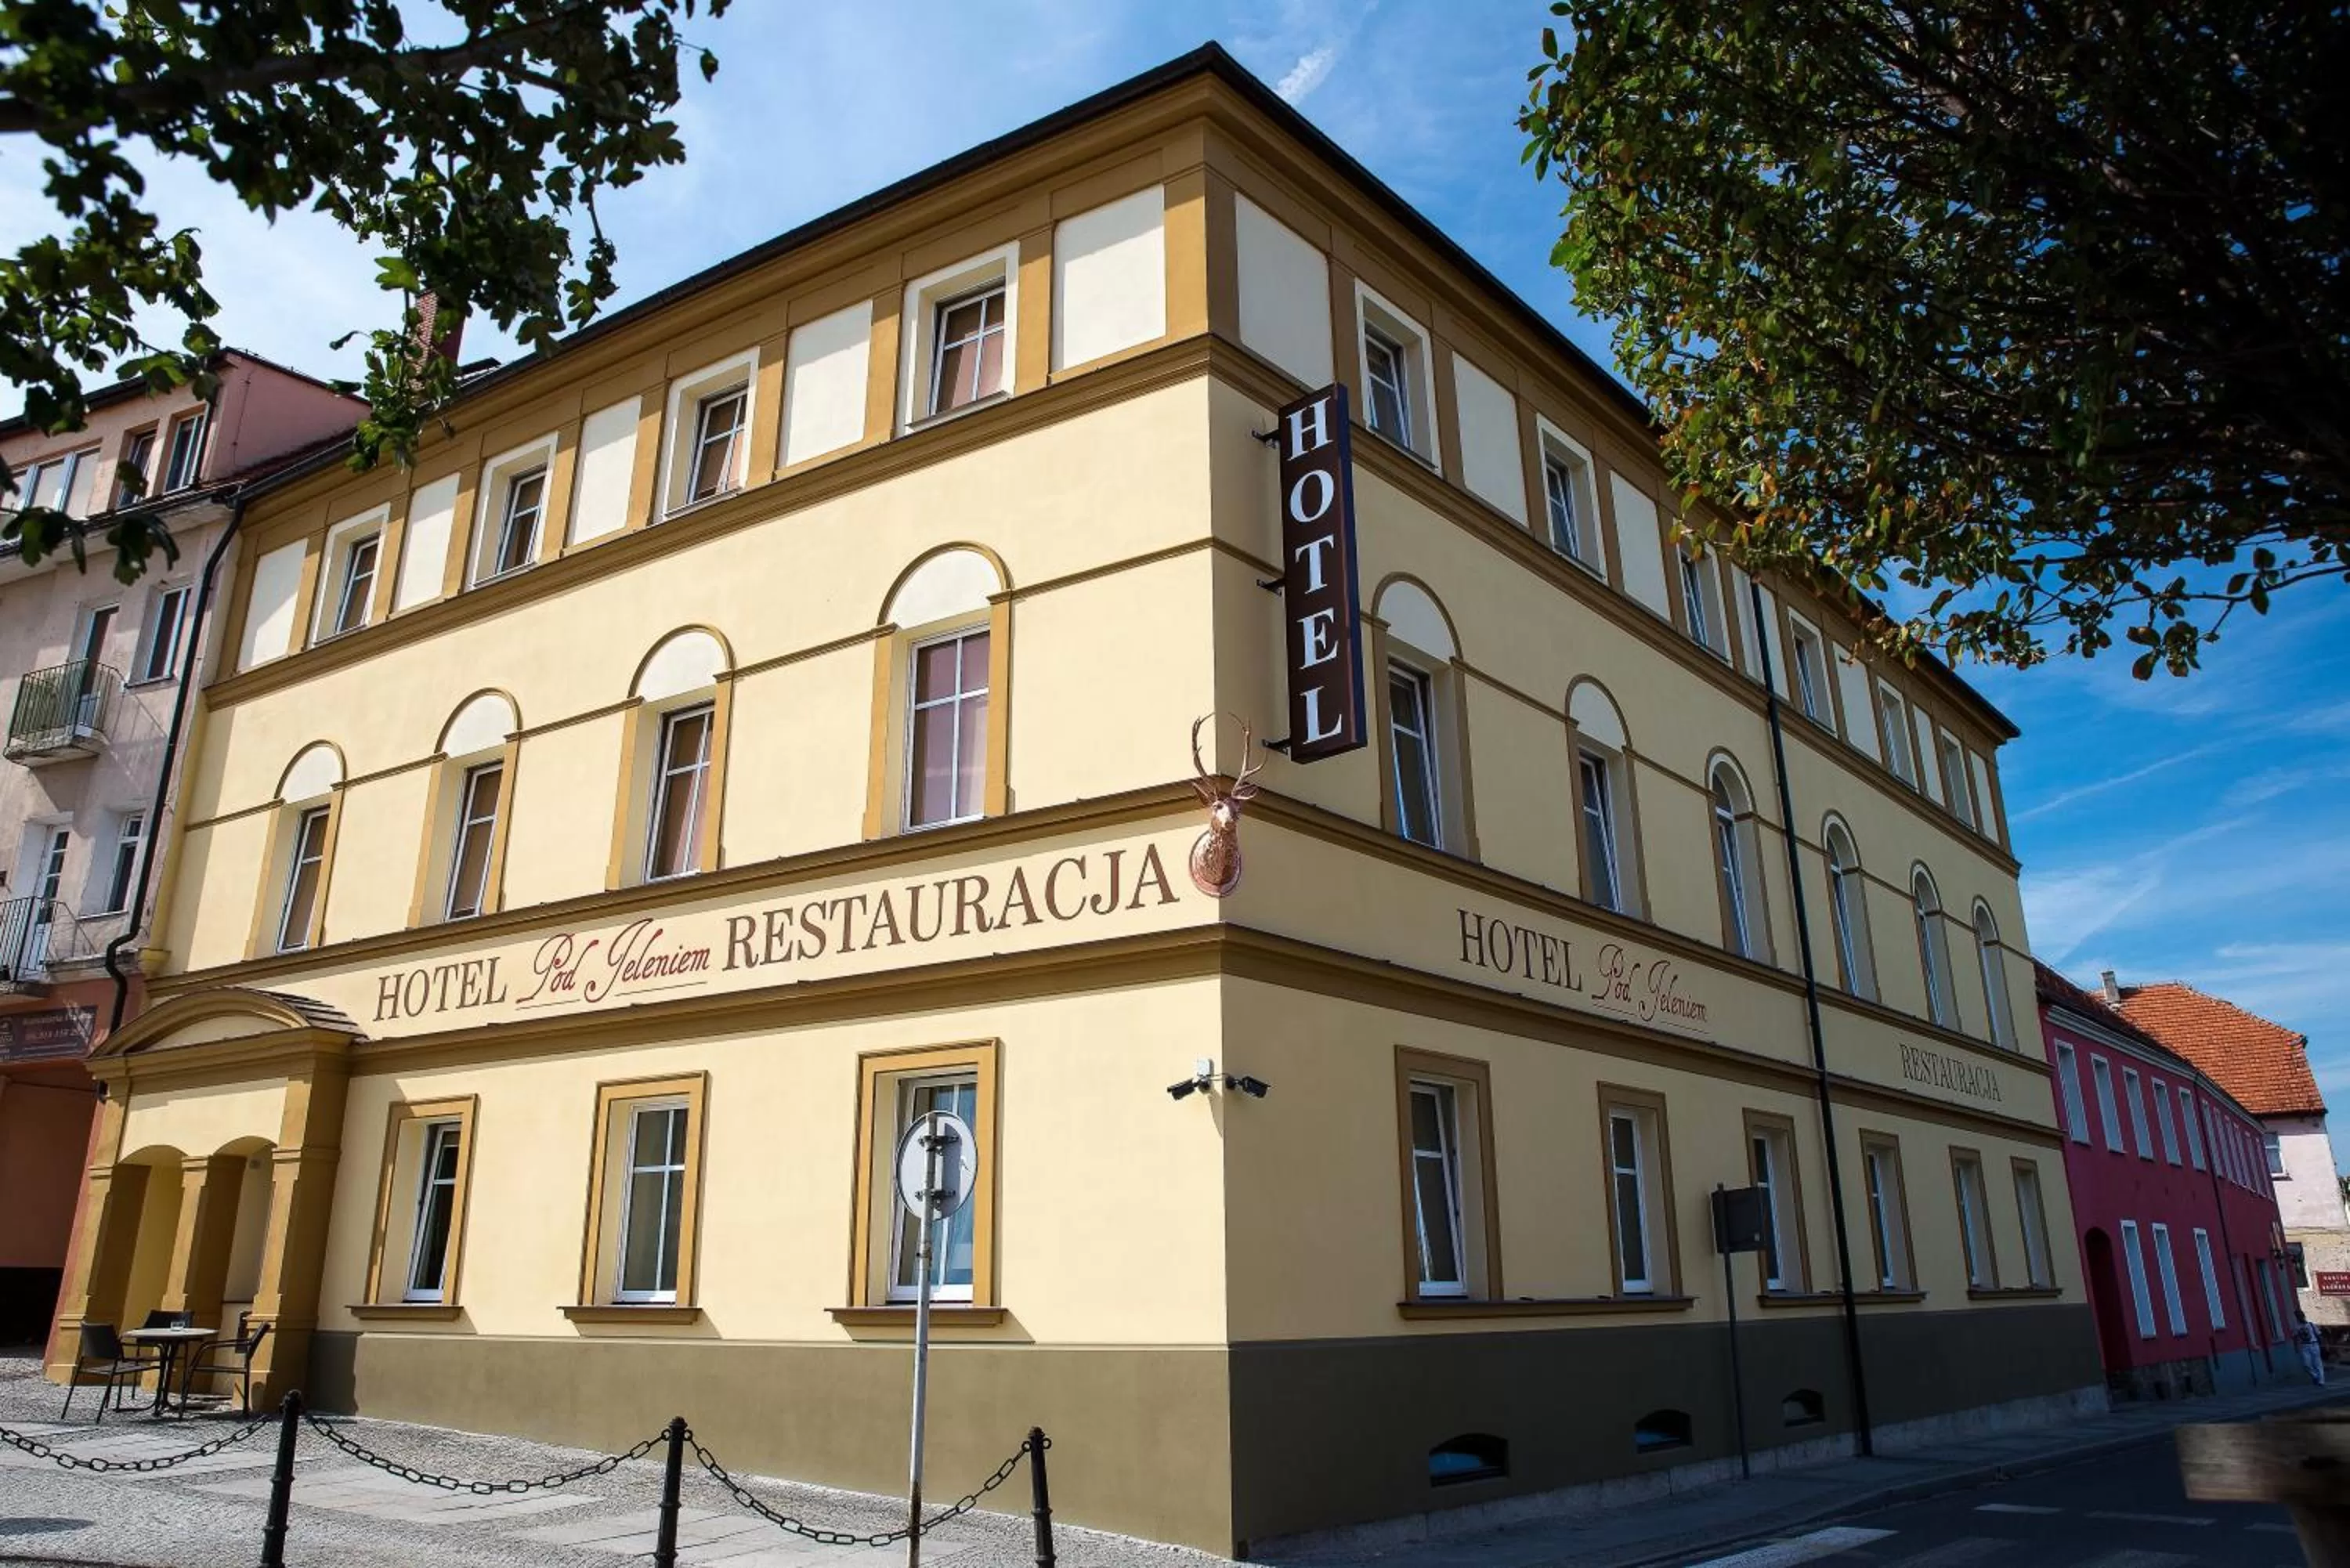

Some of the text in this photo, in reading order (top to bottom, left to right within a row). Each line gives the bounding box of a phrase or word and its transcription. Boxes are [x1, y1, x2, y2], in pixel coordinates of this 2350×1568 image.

[1285, 396, 1342, 746] HOTEL
[373, 843, 1180, 1022] HOTEL Pod Jeleniem RESTAURACJA
[1457, 909, 2002, 1102] HOTEL Pod Jeleniem RESTAURACJA
